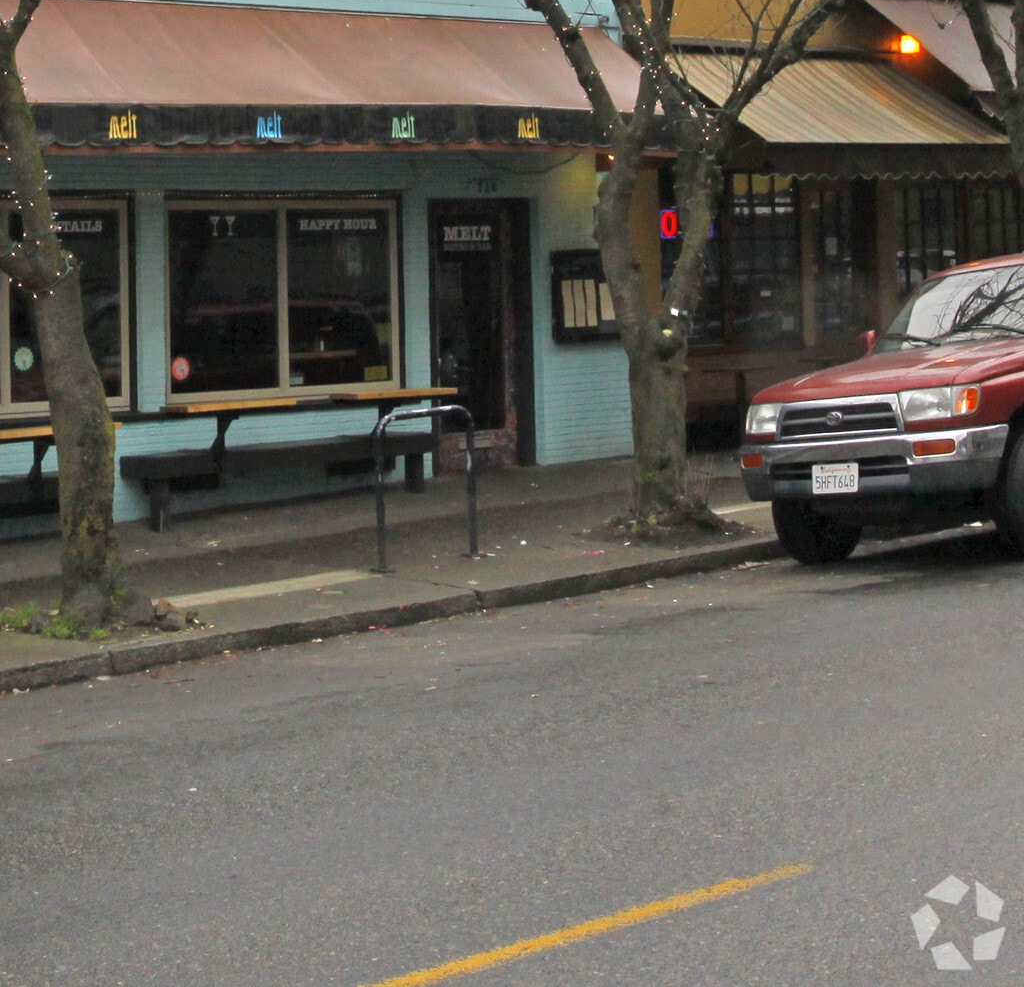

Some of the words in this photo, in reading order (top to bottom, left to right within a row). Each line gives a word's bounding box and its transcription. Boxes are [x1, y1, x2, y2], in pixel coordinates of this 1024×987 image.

[108, 108, 138, 140] melt
[256, 110, 284, 139] melt
[391, 111, 416, 139] melt
[517, 112, 541, 139] melt
[299, 218, 341, 231] HAPPY
[343, 218, 377, 230] HOUR
[443, 225, 491, 242] MELT
[815, 474, 855, 490] 5HFT648
